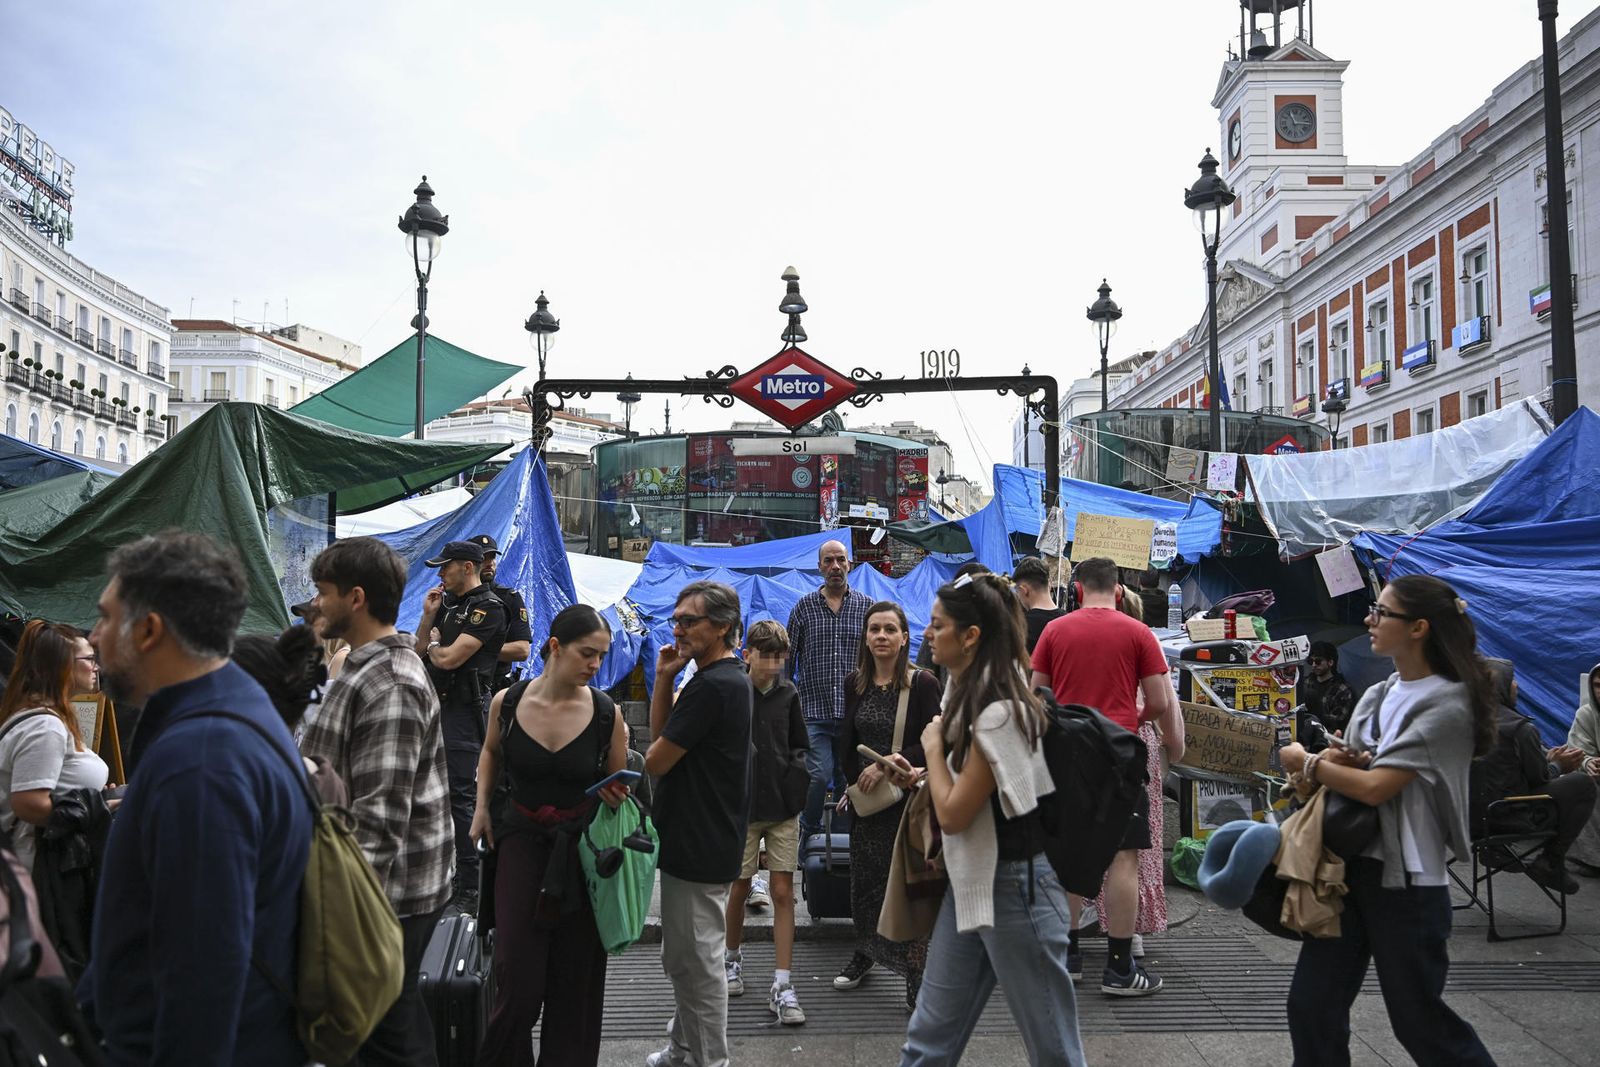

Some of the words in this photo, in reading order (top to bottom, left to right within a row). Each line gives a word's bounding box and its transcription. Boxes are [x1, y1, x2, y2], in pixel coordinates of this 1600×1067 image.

[0, 105, 75, 197] PEPE
[920, 349, 961, 378] 1919
[766, 378, 820, 395] Metro
[782, 440, 808, 453] Sol
[899, 448, 928, 456] MADRID
[1181, 707, 1220, 729] NTRADA
[1224, 718, 1237, 732] AL
[1200, 780, 1214, 797] PRO
